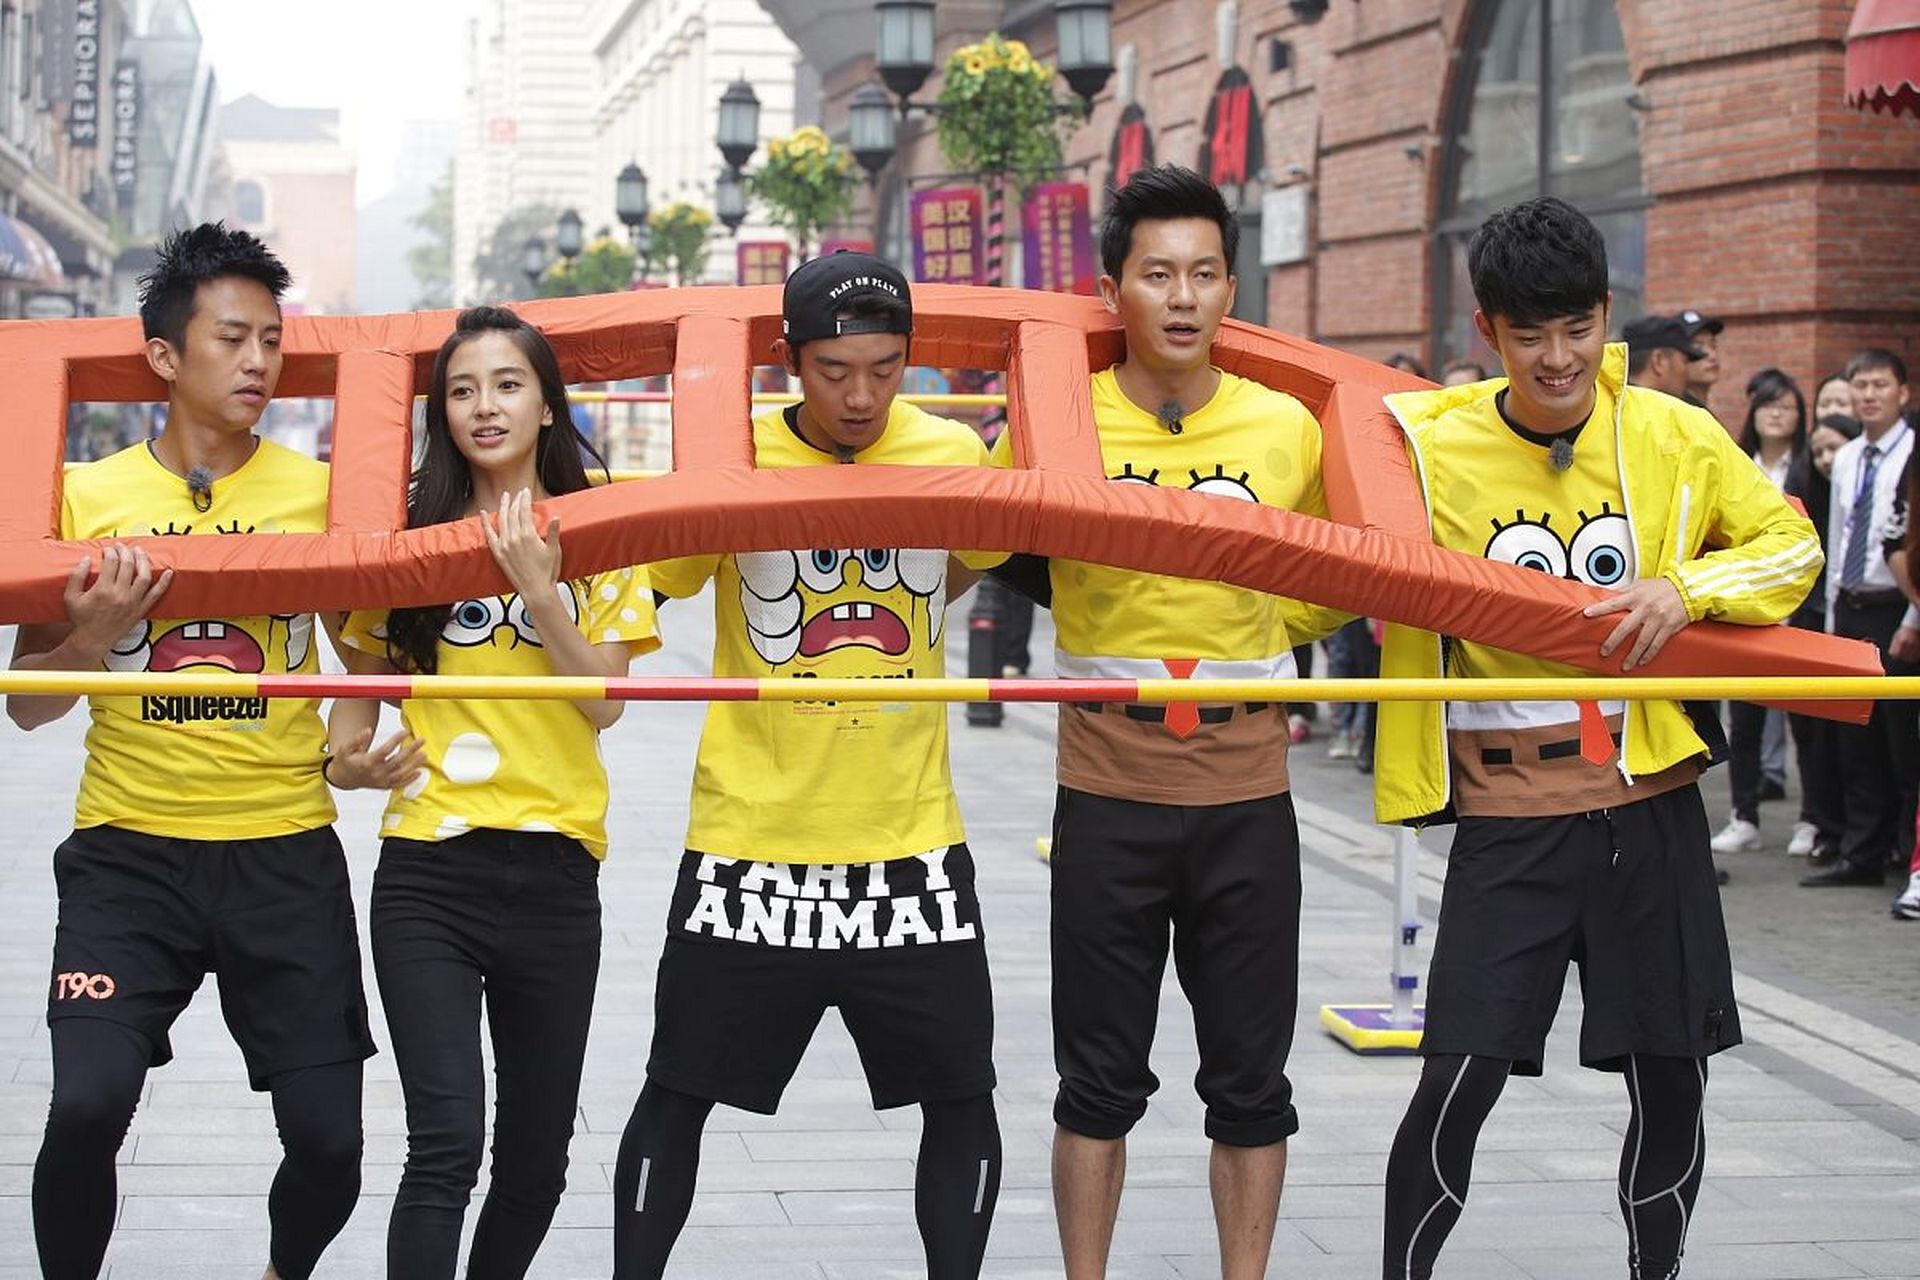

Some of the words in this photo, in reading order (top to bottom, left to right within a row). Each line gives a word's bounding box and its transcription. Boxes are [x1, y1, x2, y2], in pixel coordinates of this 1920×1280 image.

[72, 0, 97, 139] SEPHORA
[115, 67, 136, 186] SEPHORA
[829, 279, 852, 299] PLAY
[855, 276, 869, 286] ON
[684, 883, 977, 950] ANIMAL
